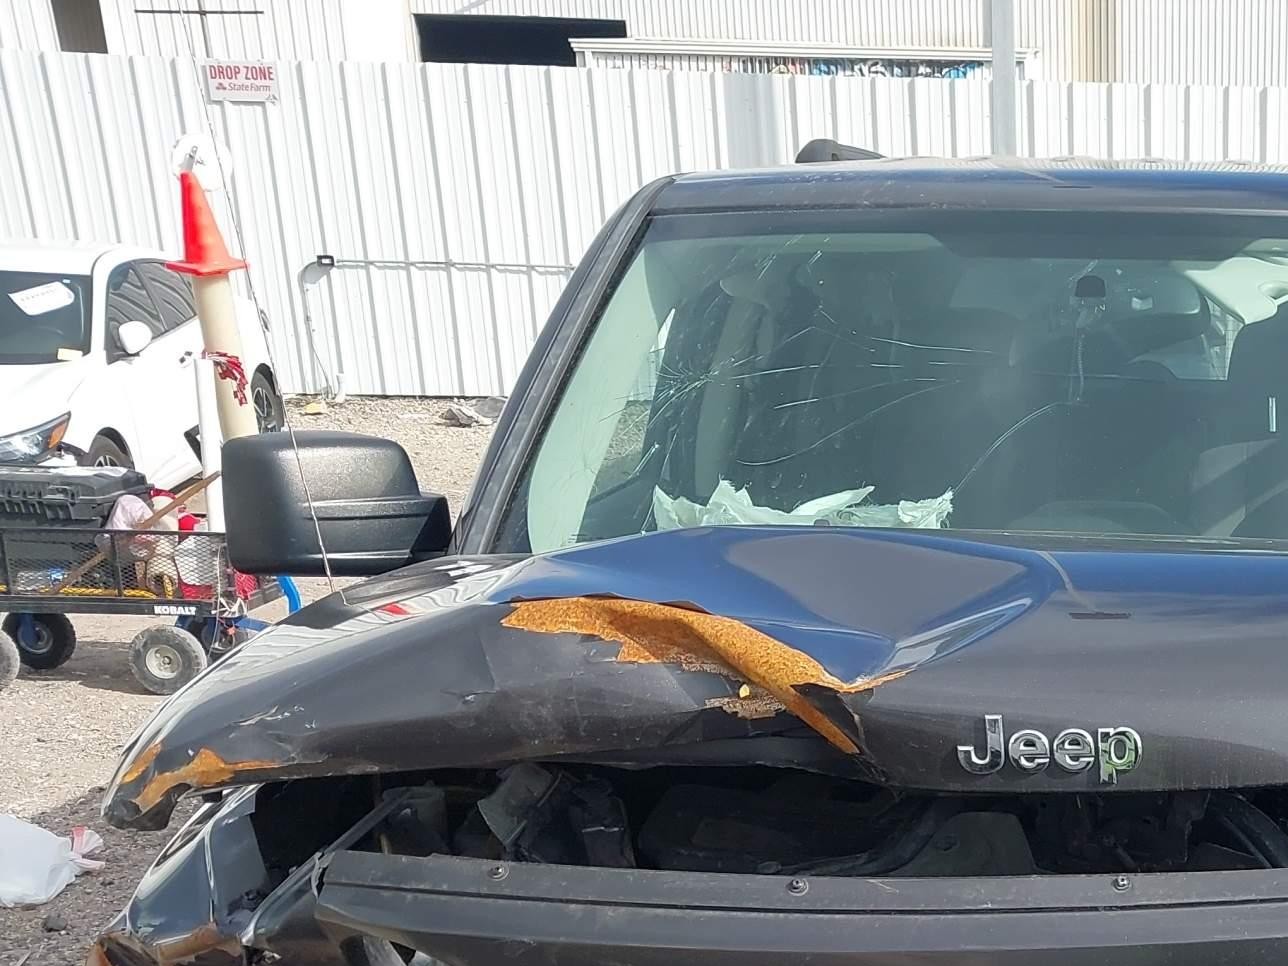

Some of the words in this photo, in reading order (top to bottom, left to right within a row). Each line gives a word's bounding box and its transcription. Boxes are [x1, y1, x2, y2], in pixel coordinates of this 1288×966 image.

[209, 65, 241, 80] DROP
[243, 65, 274, 81] ZONE
[153, 605, 197, 616] KOBALT
[957, 714, 1143, 785] Jeep
